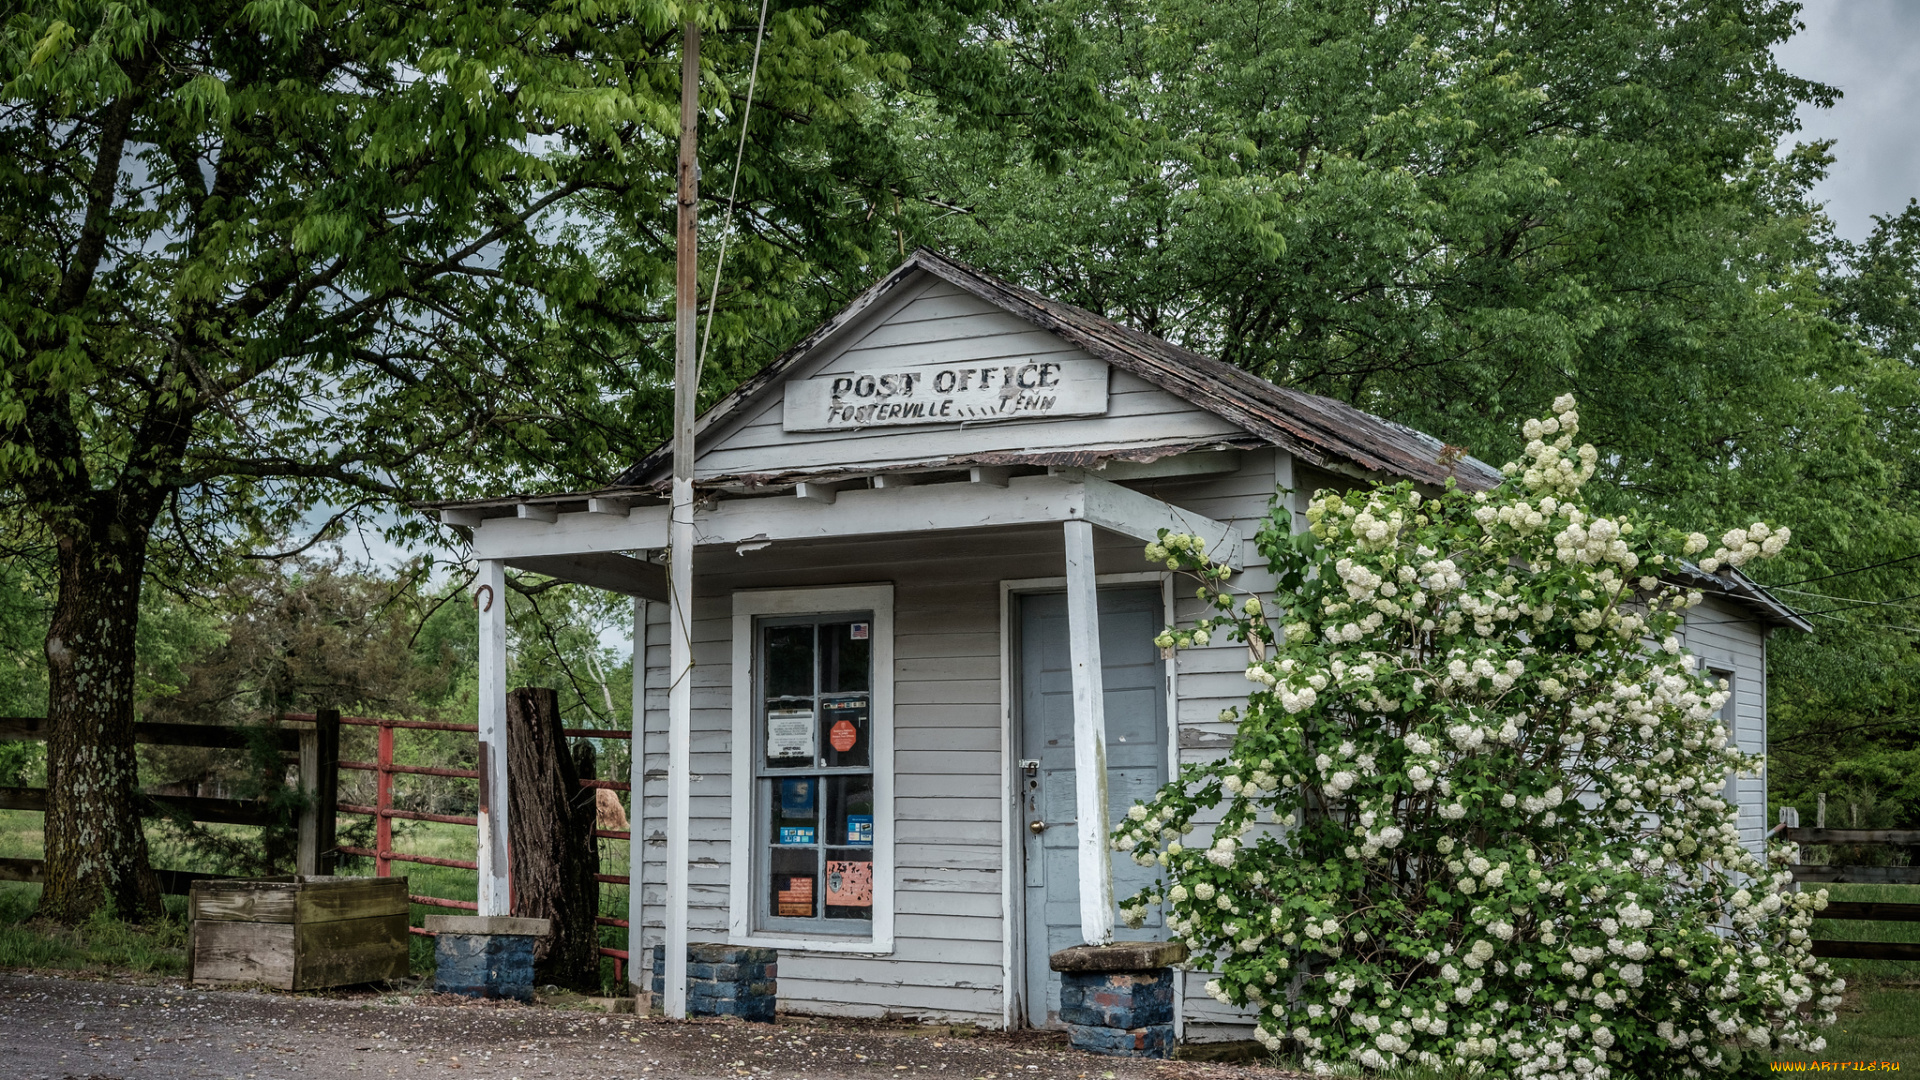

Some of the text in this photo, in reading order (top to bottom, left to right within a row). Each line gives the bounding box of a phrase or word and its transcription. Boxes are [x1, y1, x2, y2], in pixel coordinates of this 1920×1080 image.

[831, 362, 1061, 399] POST OFFICE
[828, 394, 1057, 424] FOSTERVILLE TENN
